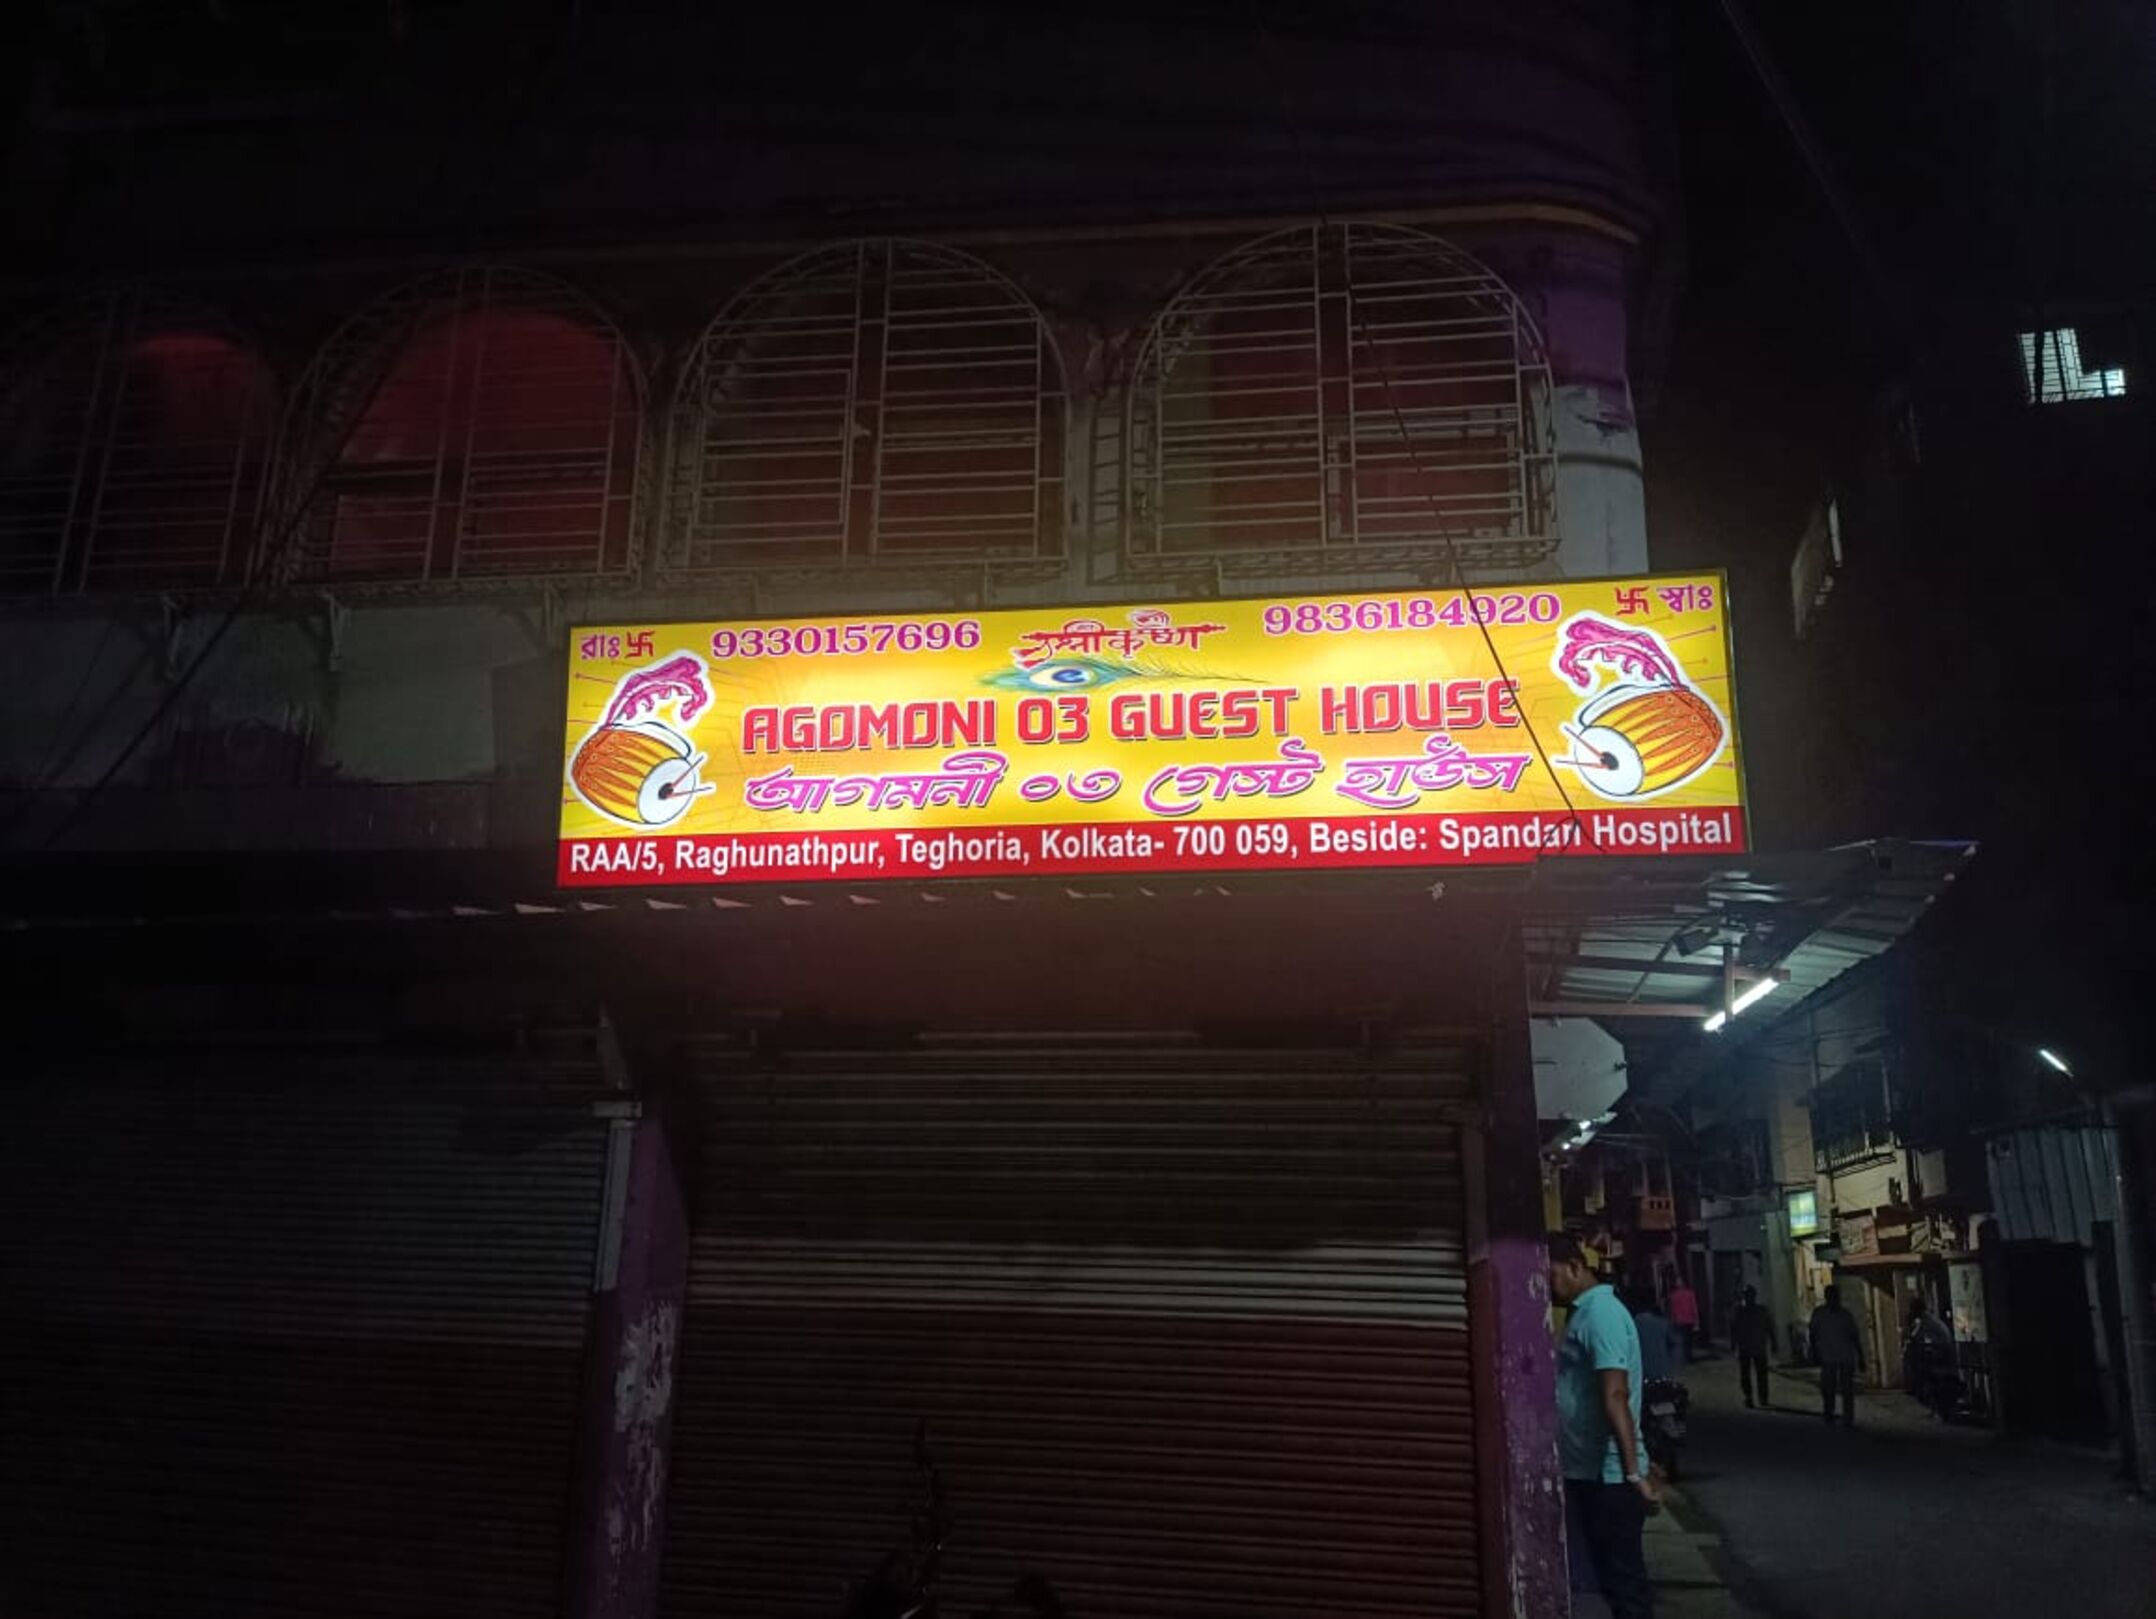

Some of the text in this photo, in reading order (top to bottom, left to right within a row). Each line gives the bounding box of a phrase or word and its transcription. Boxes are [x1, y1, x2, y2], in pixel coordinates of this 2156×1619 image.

[712, 622, 981, 658] 9330157696
[1264, 594, 1560, 634] 9836184920
[742, 678, 1522, 754] AGOMONI 03 GUEST HOUSE
[744, 734, 1532, 815] আগমনী ০৩ গেস্ট হাউস
[570, 812, 1733, 875] RAA/5, Raghunathpur, Teghoria, Kolkata- 700 059, Beside: Spandan Hospital
